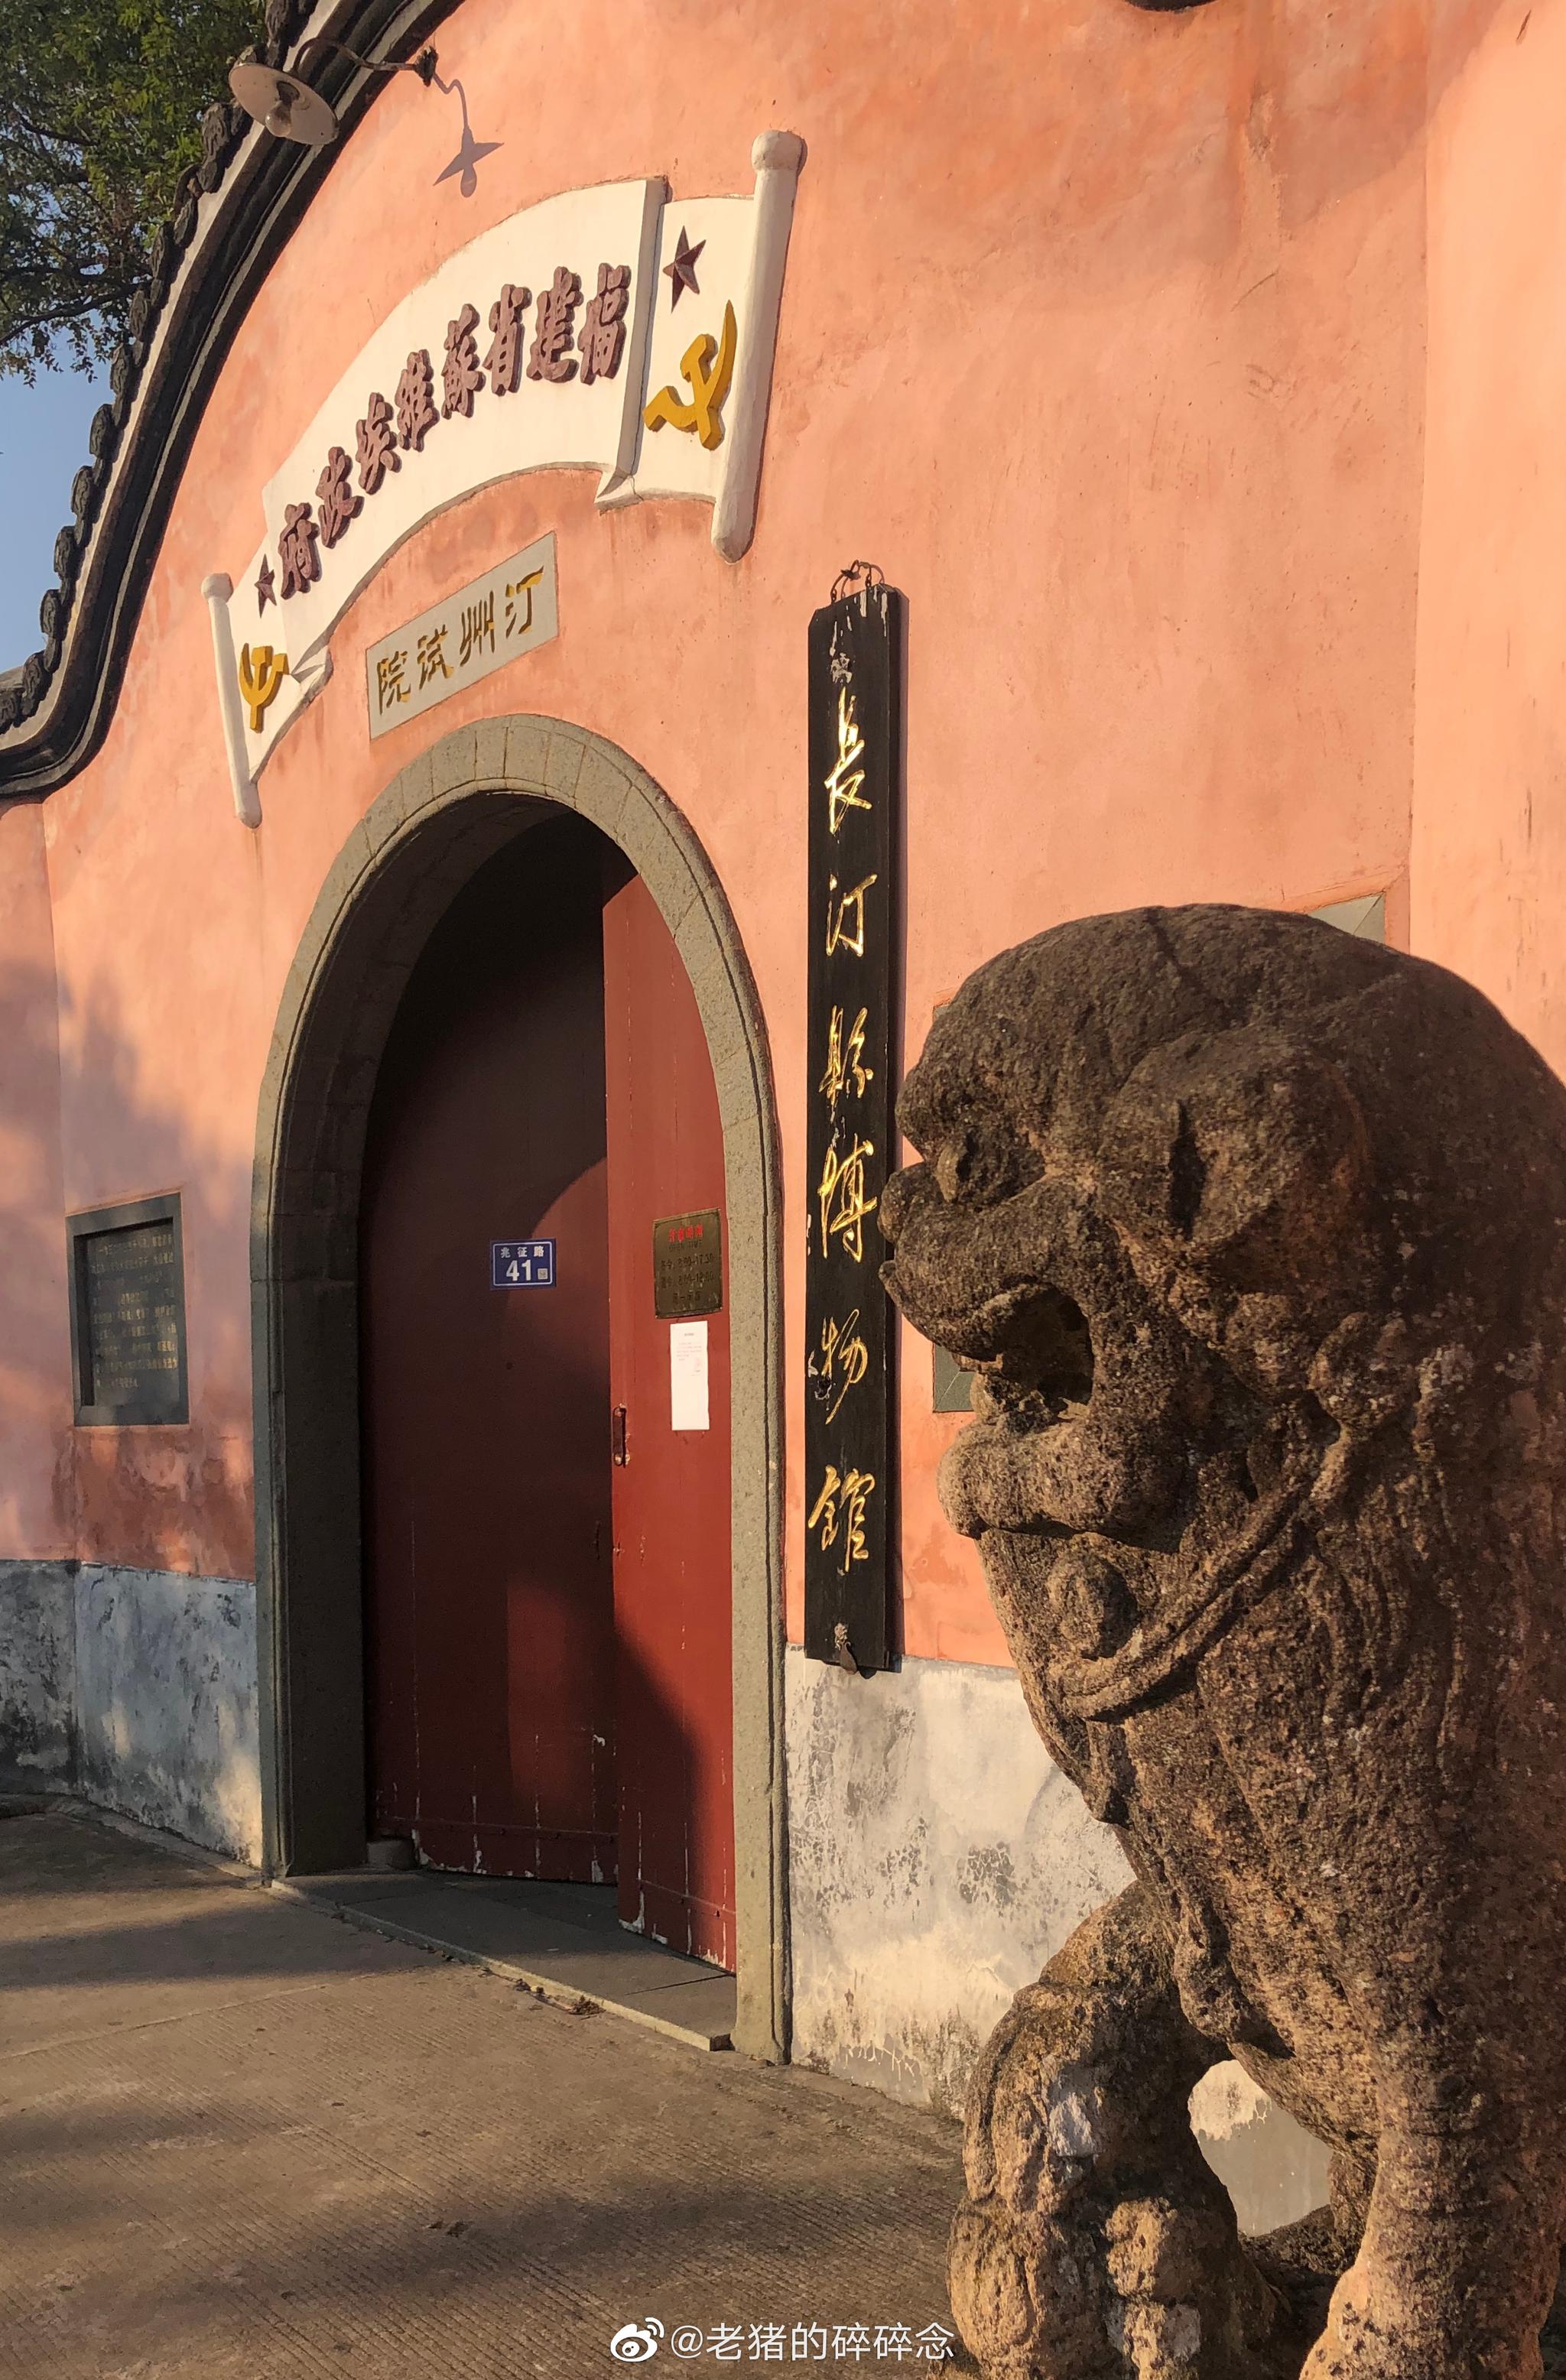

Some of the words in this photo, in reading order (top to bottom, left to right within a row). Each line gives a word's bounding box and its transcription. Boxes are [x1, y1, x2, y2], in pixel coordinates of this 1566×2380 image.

[501, 1245, 544, 1258] 兆征路
[506, 1259, 531, 1281] 41
